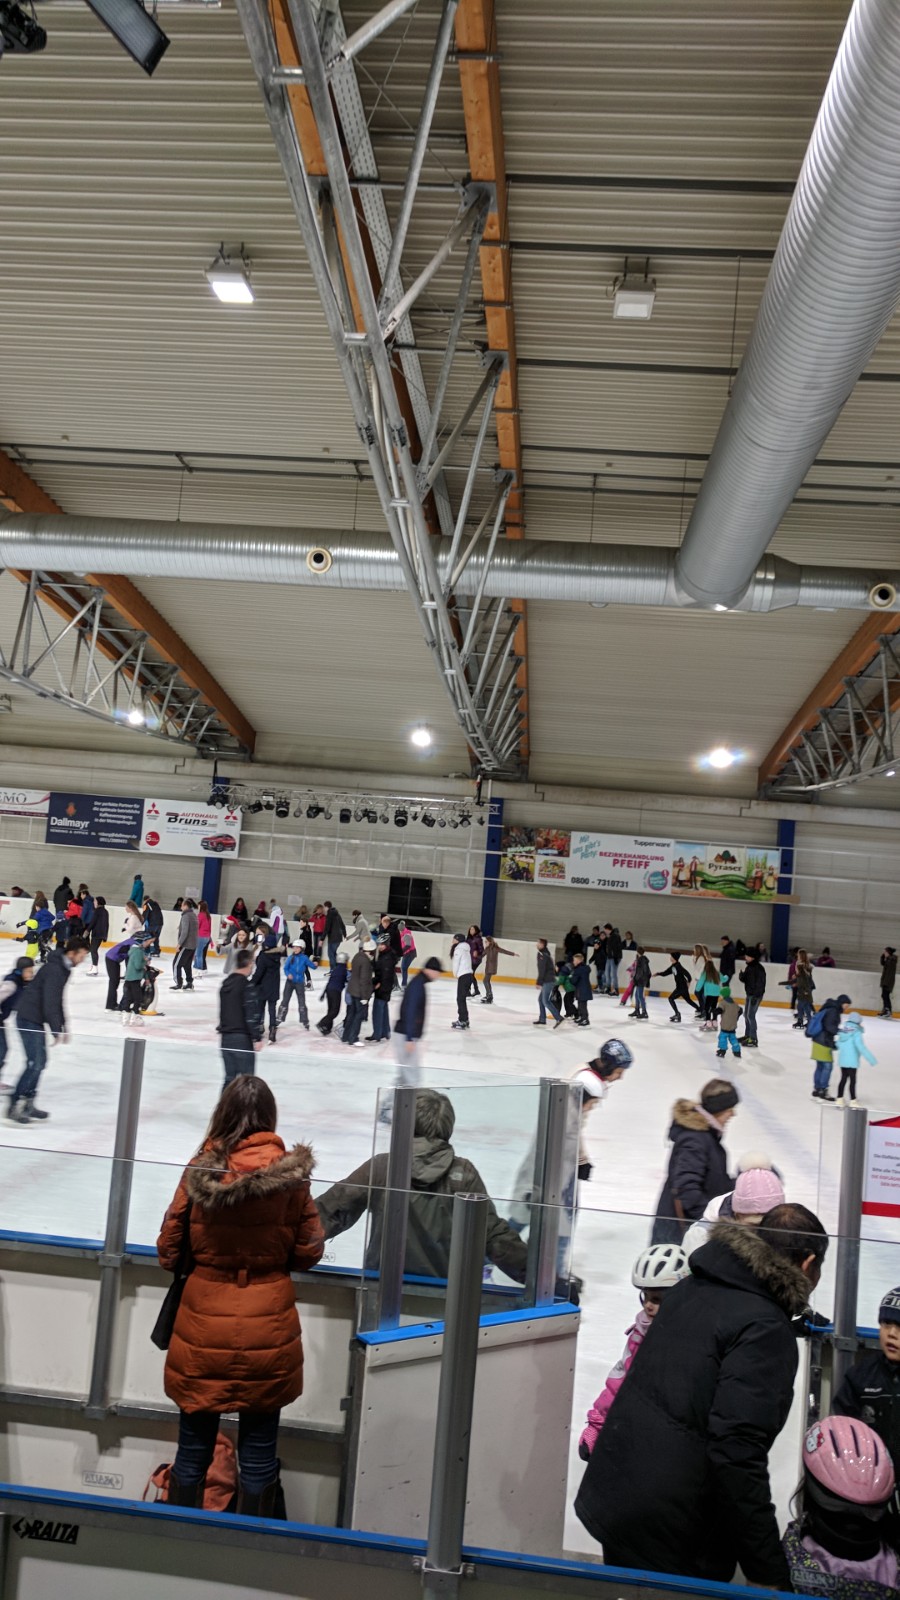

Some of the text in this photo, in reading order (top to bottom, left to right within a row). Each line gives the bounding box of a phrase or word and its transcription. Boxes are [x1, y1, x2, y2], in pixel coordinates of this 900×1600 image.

[0, 791, 27, 803] MO
[166, 813, 208, 826] Bruns
[180, 811, 218, 819] AUTOHAUS
[50, 816, 90, 829] Dallmayr
[634, 840, 671, 848] Tupperware
[599, 851, 665, 862] BEZIRKSHANDLUNG
[612, 858, 650, 869] PFEIFF
[708, 863, 742, 872] Pyraser
[571, 876, 590, 885] 0800
[28, 1519, 80, 1545] RAITA
